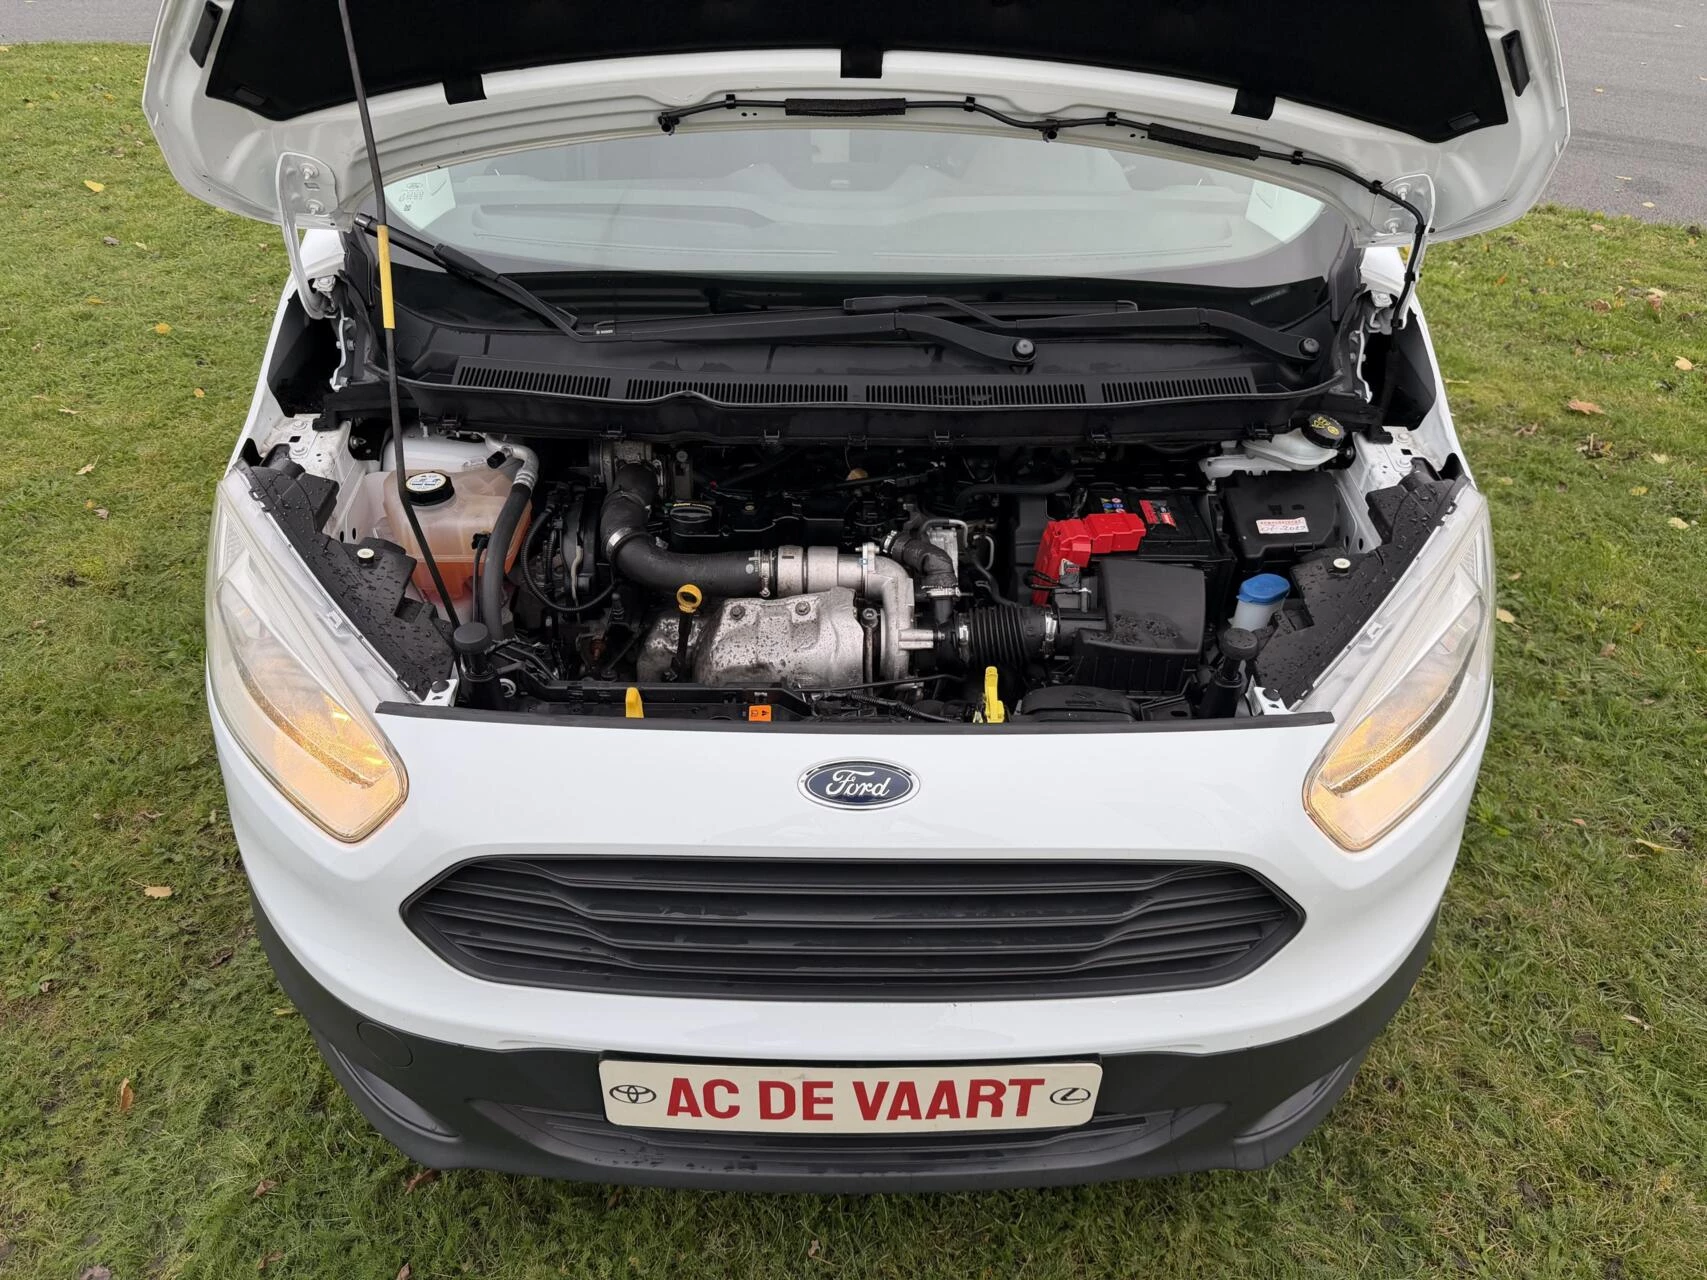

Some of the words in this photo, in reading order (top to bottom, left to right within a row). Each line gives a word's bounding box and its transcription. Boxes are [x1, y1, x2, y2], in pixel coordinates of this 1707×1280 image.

[825, 769, 891, 797] Ford
[667, 1078, 740, 1119] AC
[759, 1080, 834, 1120] DE
[852, 1078, 1045, 1121] VAART
